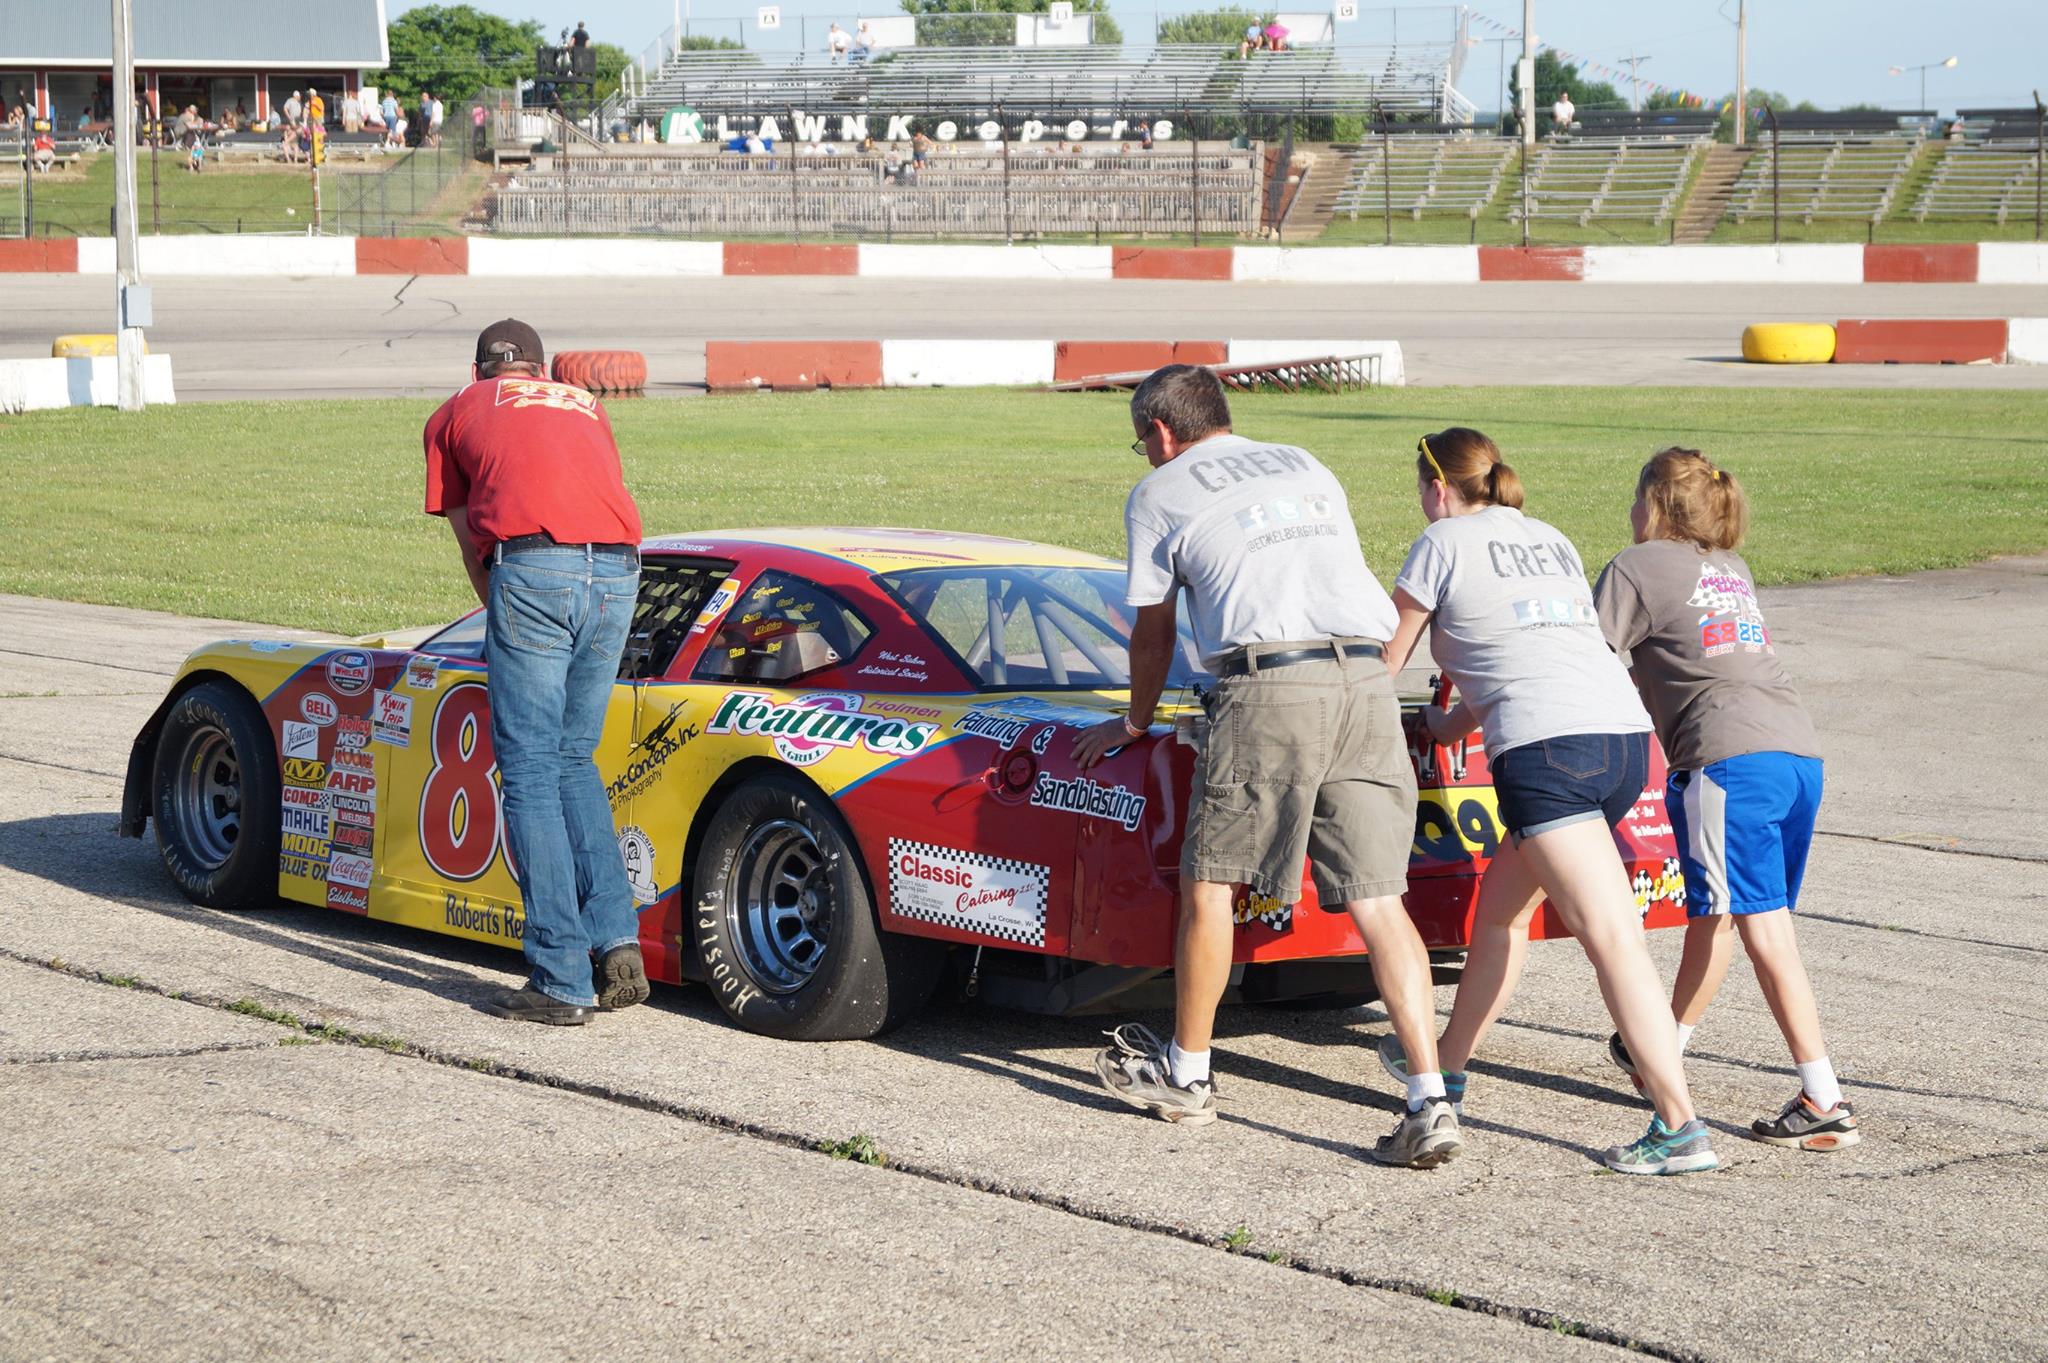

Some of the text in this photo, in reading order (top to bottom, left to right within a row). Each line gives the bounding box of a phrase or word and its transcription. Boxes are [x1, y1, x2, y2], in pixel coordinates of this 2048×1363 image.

[1189, 447, 1310, 493] CREW
[1487, 540, 1583, 578] CREW
[306, 699, 332, 717] BELL
[868, 700, 941, 718] Holmen
[708, 690, 934, 752] Features
[954, 711, 1027, 748] Painting
[1032, 726, 1056, 754] &
[337, 732, 366, 747] MSD
[786, 749, 824, 763] GRILL
[327, 771, 376, 793] ARP
[617, 768, 663, 807] Photography
[283, 788, 320, 804] COMP
[334, 796, 369, 813] LINCOLN
[1031, 772, 1146, 831] Sandblasting
[341, 811, 371, 825] WELDERS
[281, 833, 331, 858] MOOG
[900, 854, 973, 889] Classic
[956, 887, 1018, 913] Catering
